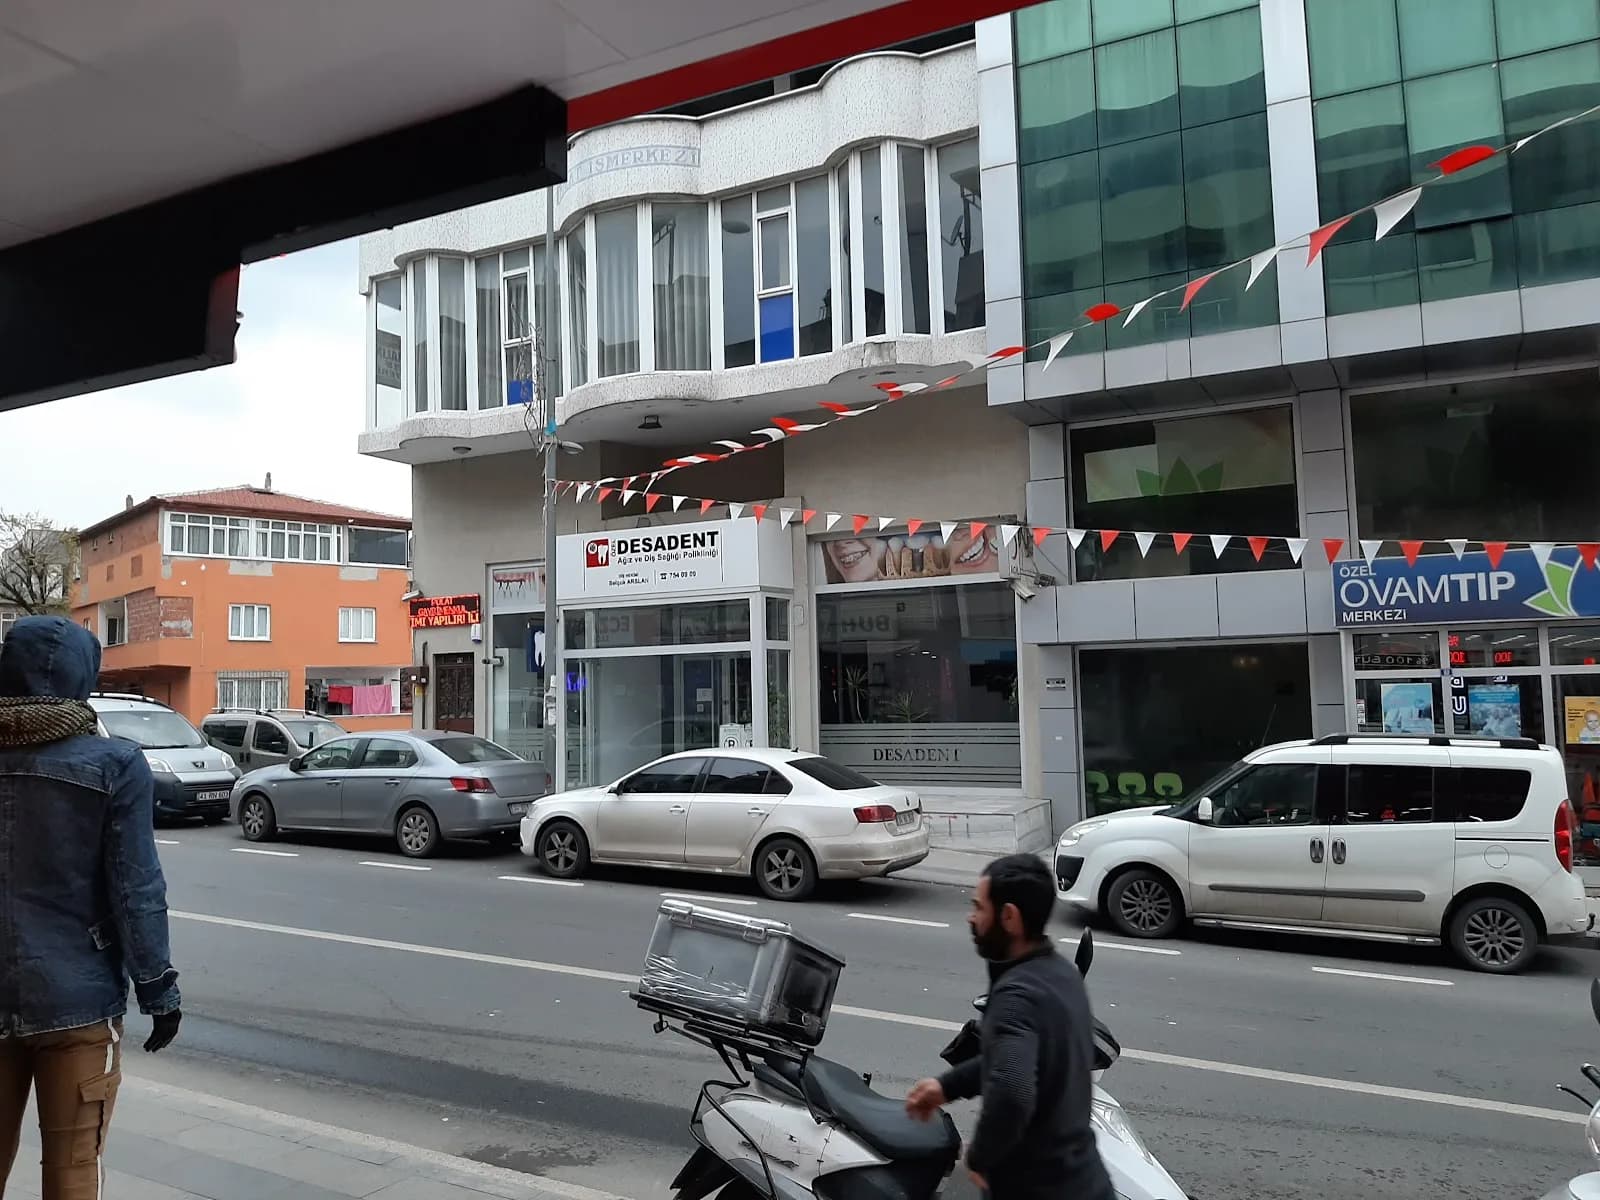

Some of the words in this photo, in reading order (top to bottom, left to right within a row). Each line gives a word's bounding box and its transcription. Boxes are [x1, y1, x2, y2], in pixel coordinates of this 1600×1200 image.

[617, 531, 719, 555] DESADENT
[617, 556, 633, 565] Ağız
[635, 555, 643, 563] ve
[644, 553, 656, 562] Diş
[658, 551, 682, 561] Sağlığı
[1339, 563, 1377, 578] ÖZEL
[1340, 571, 1516, 608] OVAMTIP
[873, 748, 962, 762] DESADENT
